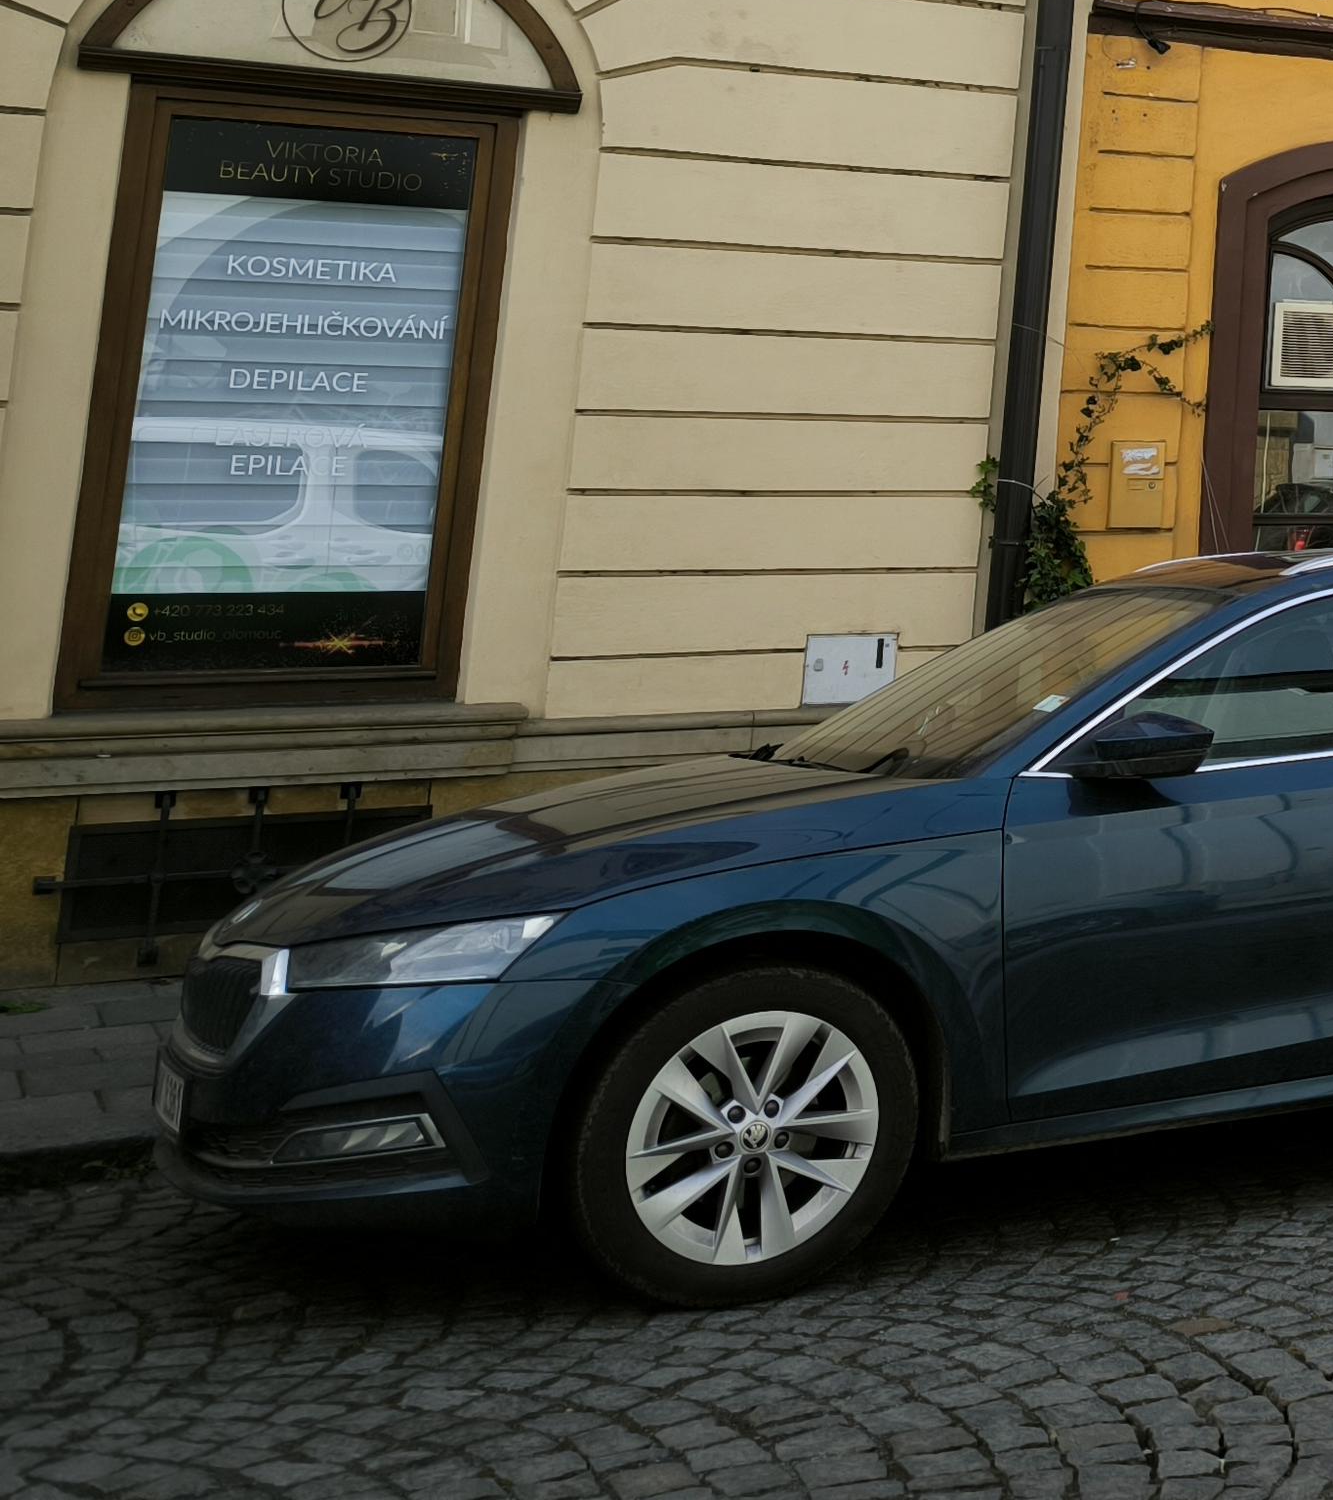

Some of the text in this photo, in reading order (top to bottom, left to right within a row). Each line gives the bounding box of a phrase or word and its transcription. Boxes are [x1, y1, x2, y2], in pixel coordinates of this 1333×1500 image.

[266, 140, 384, 167] VIKTORIA
[219, 160, 423, 192] BEAUTY STUDIO
[226, 254, 397, 283] KOSMETIKA
[159, 308, 449, 340] MIKROJEHLIČKOVÁNÍ
[229, 368, 369, 393] DEPILACE
[215, 423, 367, 449] LASEROVÁ
[230, 454, 348, 477] EPILACE
[153, 604, 190, 618] +420
